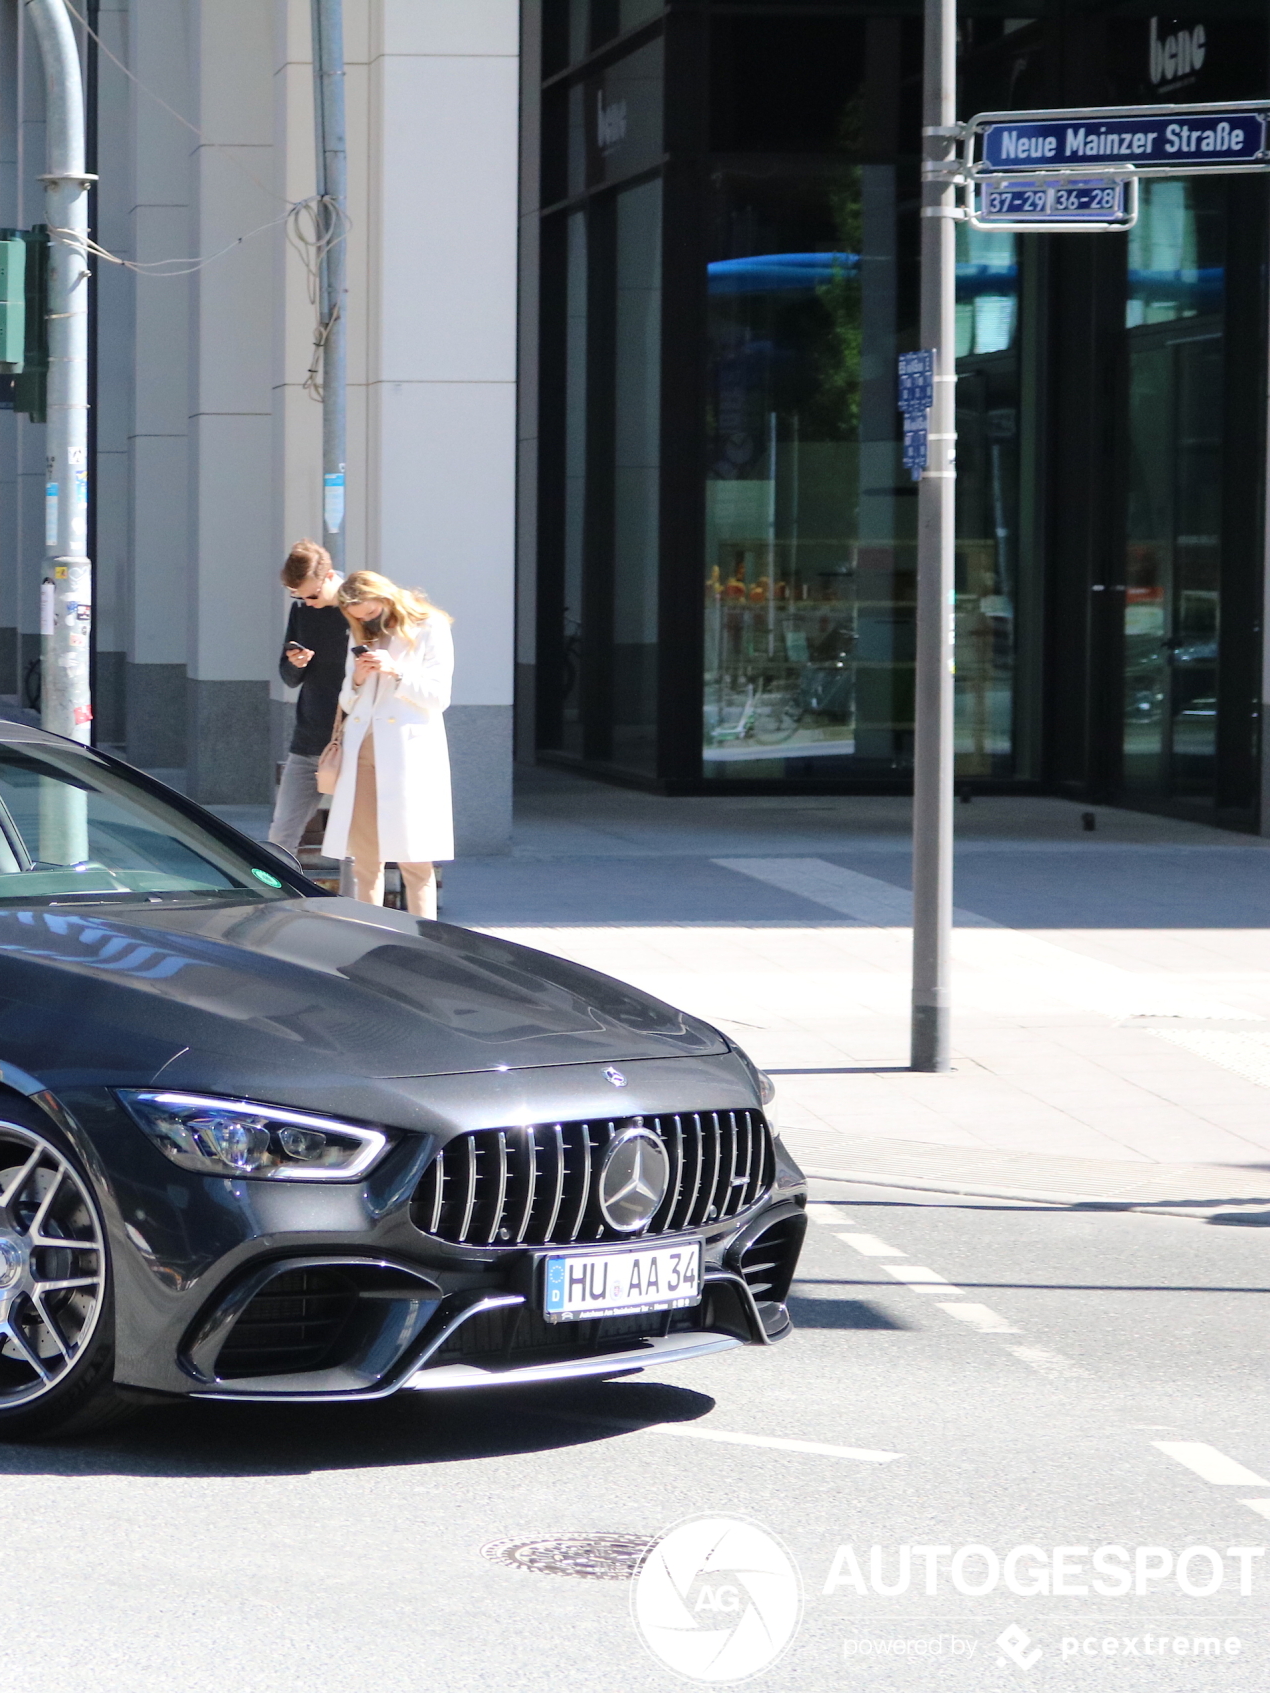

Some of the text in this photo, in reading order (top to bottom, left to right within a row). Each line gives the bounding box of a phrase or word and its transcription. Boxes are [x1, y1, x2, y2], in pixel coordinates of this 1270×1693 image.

[1150, 16, 1206, 84] bene
[1001, 122, 1244, 159] Neue Mainzer Straße
[990, 187, 1114, 212] 37-29 36-28
[568, 1251, 696, 1303] HU AA 34
[552, 1290, 559, 1302] D
